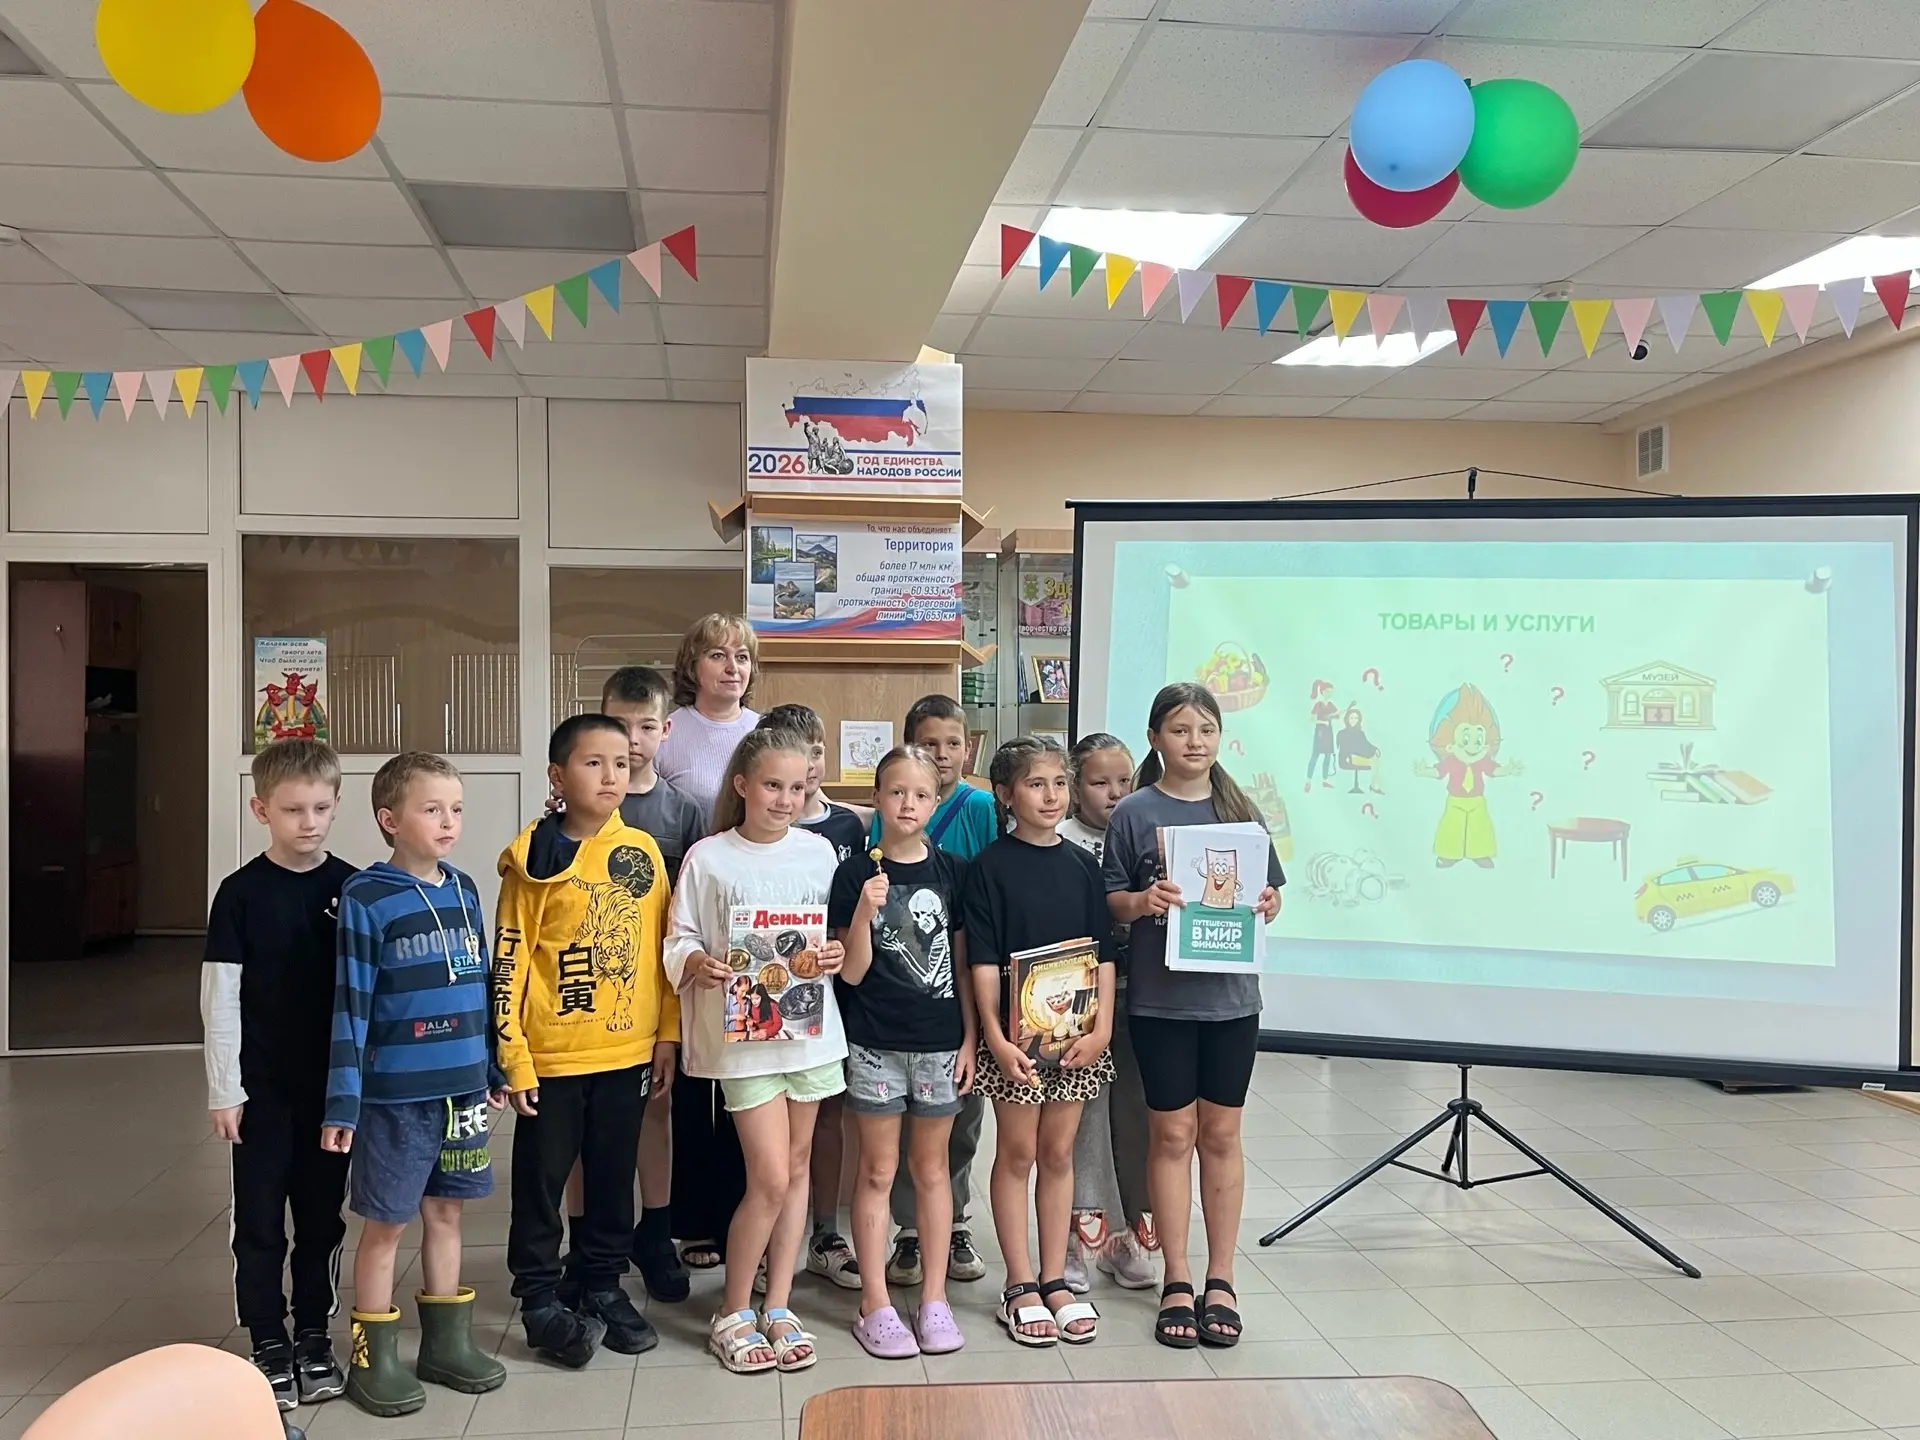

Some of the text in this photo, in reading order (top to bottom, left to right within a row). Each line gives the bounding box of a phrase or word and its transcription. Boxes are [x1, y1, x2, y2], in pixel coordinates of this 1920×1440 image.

[748, 453, 805, 474] 2026
[857, 455, 943, 467] ГОД ЕДИНСТВА
[856, 467, 962, 478] НАРОДОВ РОССИИ
[867, 523, 876, 533] То,
[884, 538, 954, 553] Территория
[880, 561, 907, 571] более
[909, 561, 917, 570] 17
[855, 573, 886, 583] общая
[870, 587, 902, 596] границ
[911, 586, 921, 595] 60
[924, 586, 939, 595] 933
[908, 599, 956, 609] береговой
[877, 611, 906, 620] линии
[913, 611, 924, 620] 37
[926, 611, 941, 620] 653
[942, 612, 956, 620] км
[1378, 613, 1595, 632] ТОВАРЫ И УСЛУГИ
[753, 910, 823, 929] Деньги
[1192, 918, 1243, 928] ПУТЕШЕСТВИЕ
[1192, 926, 1242, 941] В МИР
[1191, 940, 1242, 950] ФИНАНСОВ
[454, 955, 481, 967] STA
